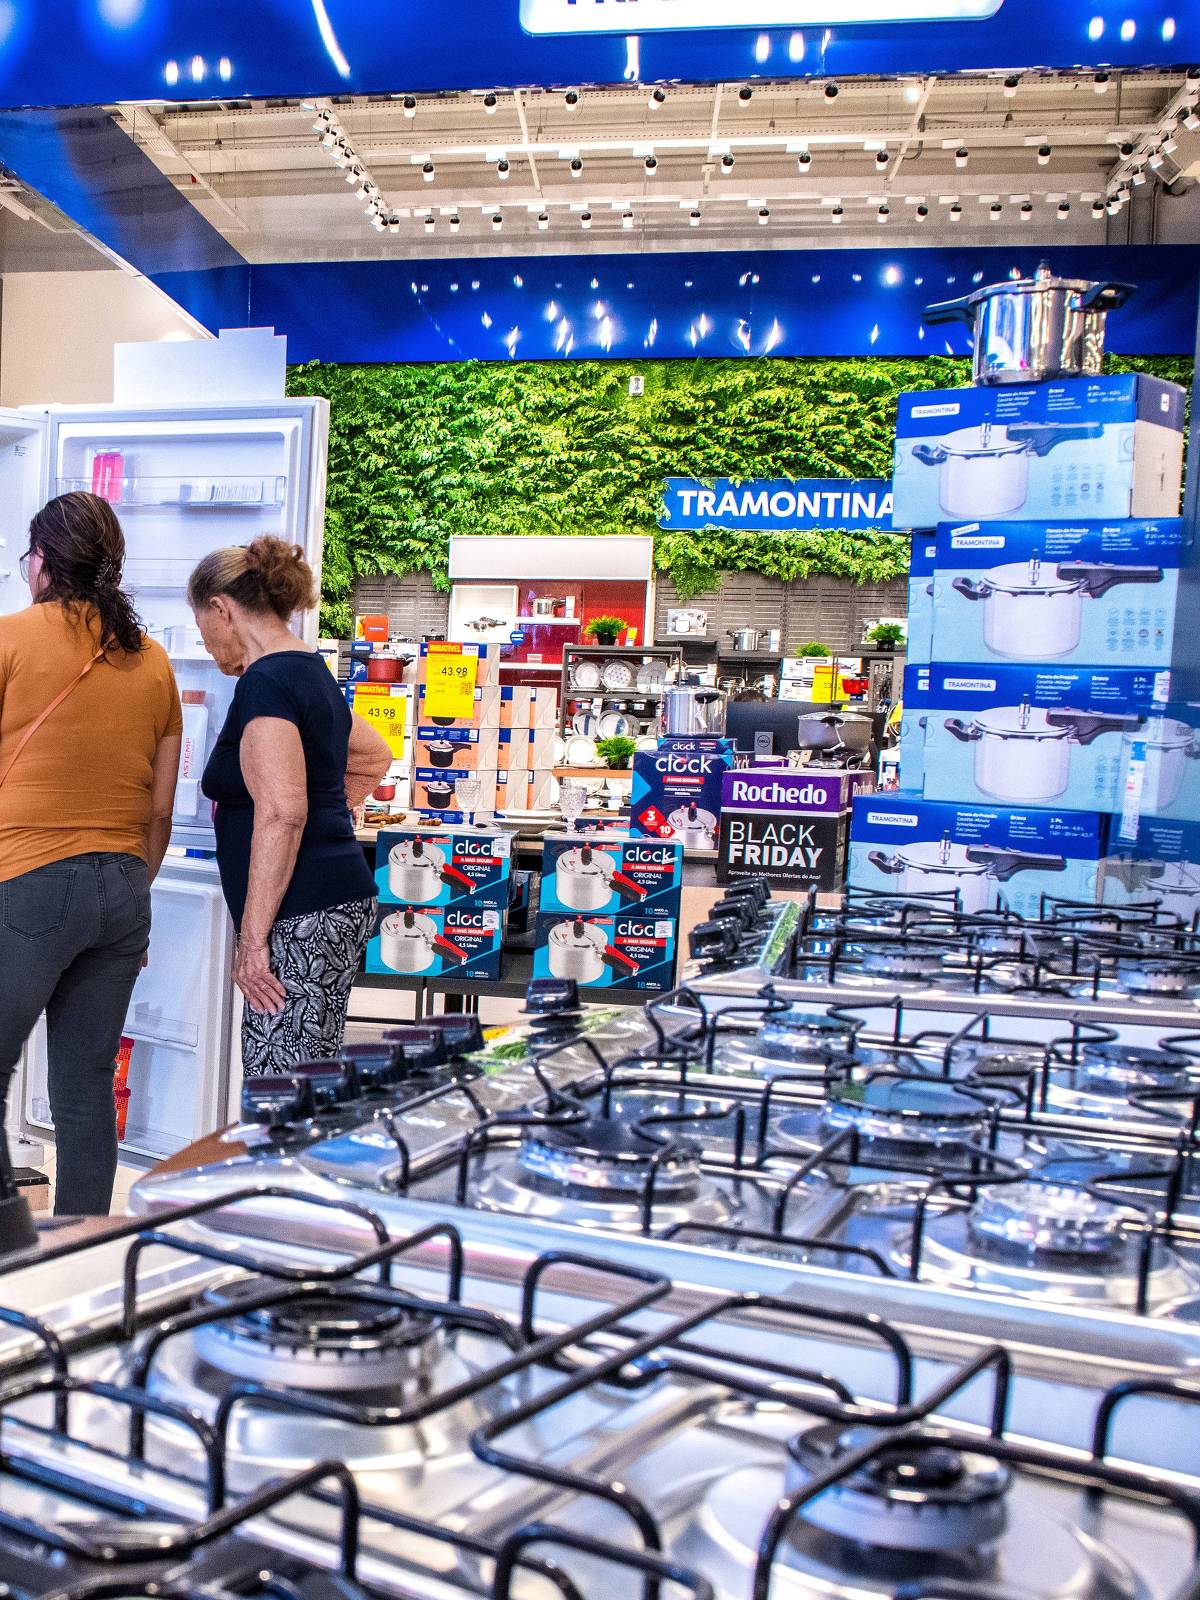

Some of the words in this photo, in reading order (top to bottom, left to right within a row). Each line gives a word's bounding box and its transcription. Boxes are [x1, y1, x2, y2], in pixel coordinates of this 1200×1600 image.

[915, 406, 956, 415] TRAMONTINA
[677, 490, 893, 518] TRAMONTINA
[429, 643, 462, 653] IMBATÍVEL
[356, 684, 390, 694] IMBATÍVEL
[947, 681, 991, 689] TRAMONTINA
[672, 741, 696, 751] clock
[182, 737, 192, 778] ASTEMP
[655, 753, 712, 774] clock
[732, 780, 827, 805] Rochedo
[647, 810, 655, 820] 3
[871, 816, 913, 824] TRAMONTINA
[659, 826, 671, 834] 10
[729, 821, 815, 846] BLACK
[625, 846, 672, 863] clock
[728, 844, 823, 868] FRIDAY
[463, 864, 491, 872] ORIGINAL
[728, 869, 750, 877] Aproveite
[447, 910, 484, 926] cloc
[618, 920, 654, 936] cloc
[454, 935, 482, 943] ORIGINAL
[625, 945, 655, 953] ORIGINAL
